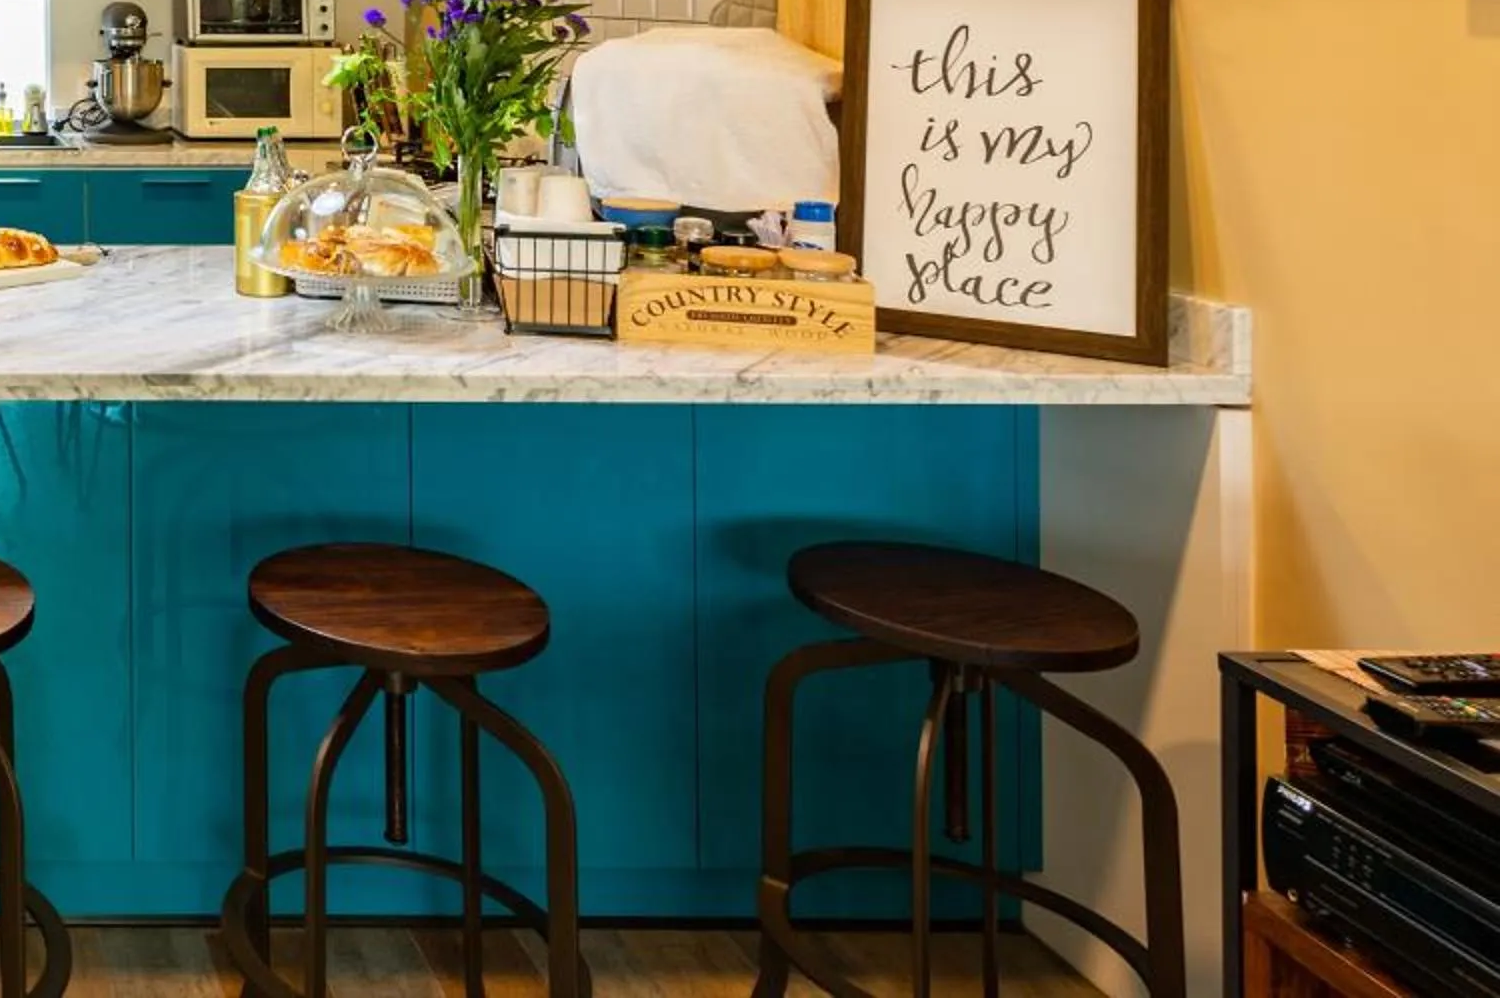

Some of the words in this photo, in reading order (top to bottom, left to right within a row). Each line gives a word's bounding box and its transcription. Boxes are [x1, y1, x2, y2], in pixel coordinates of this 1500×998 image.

[891, 25, 1043, 98] this
[920, 117, 959, 161] is
[980, 121, 1092, 178] my
[899, 163, 1069, 264] happy
[905, 238, 1053, 307] place
[631, 285, 763, 327] COUNTRY
[772, 290, 855, 339] STYLE
